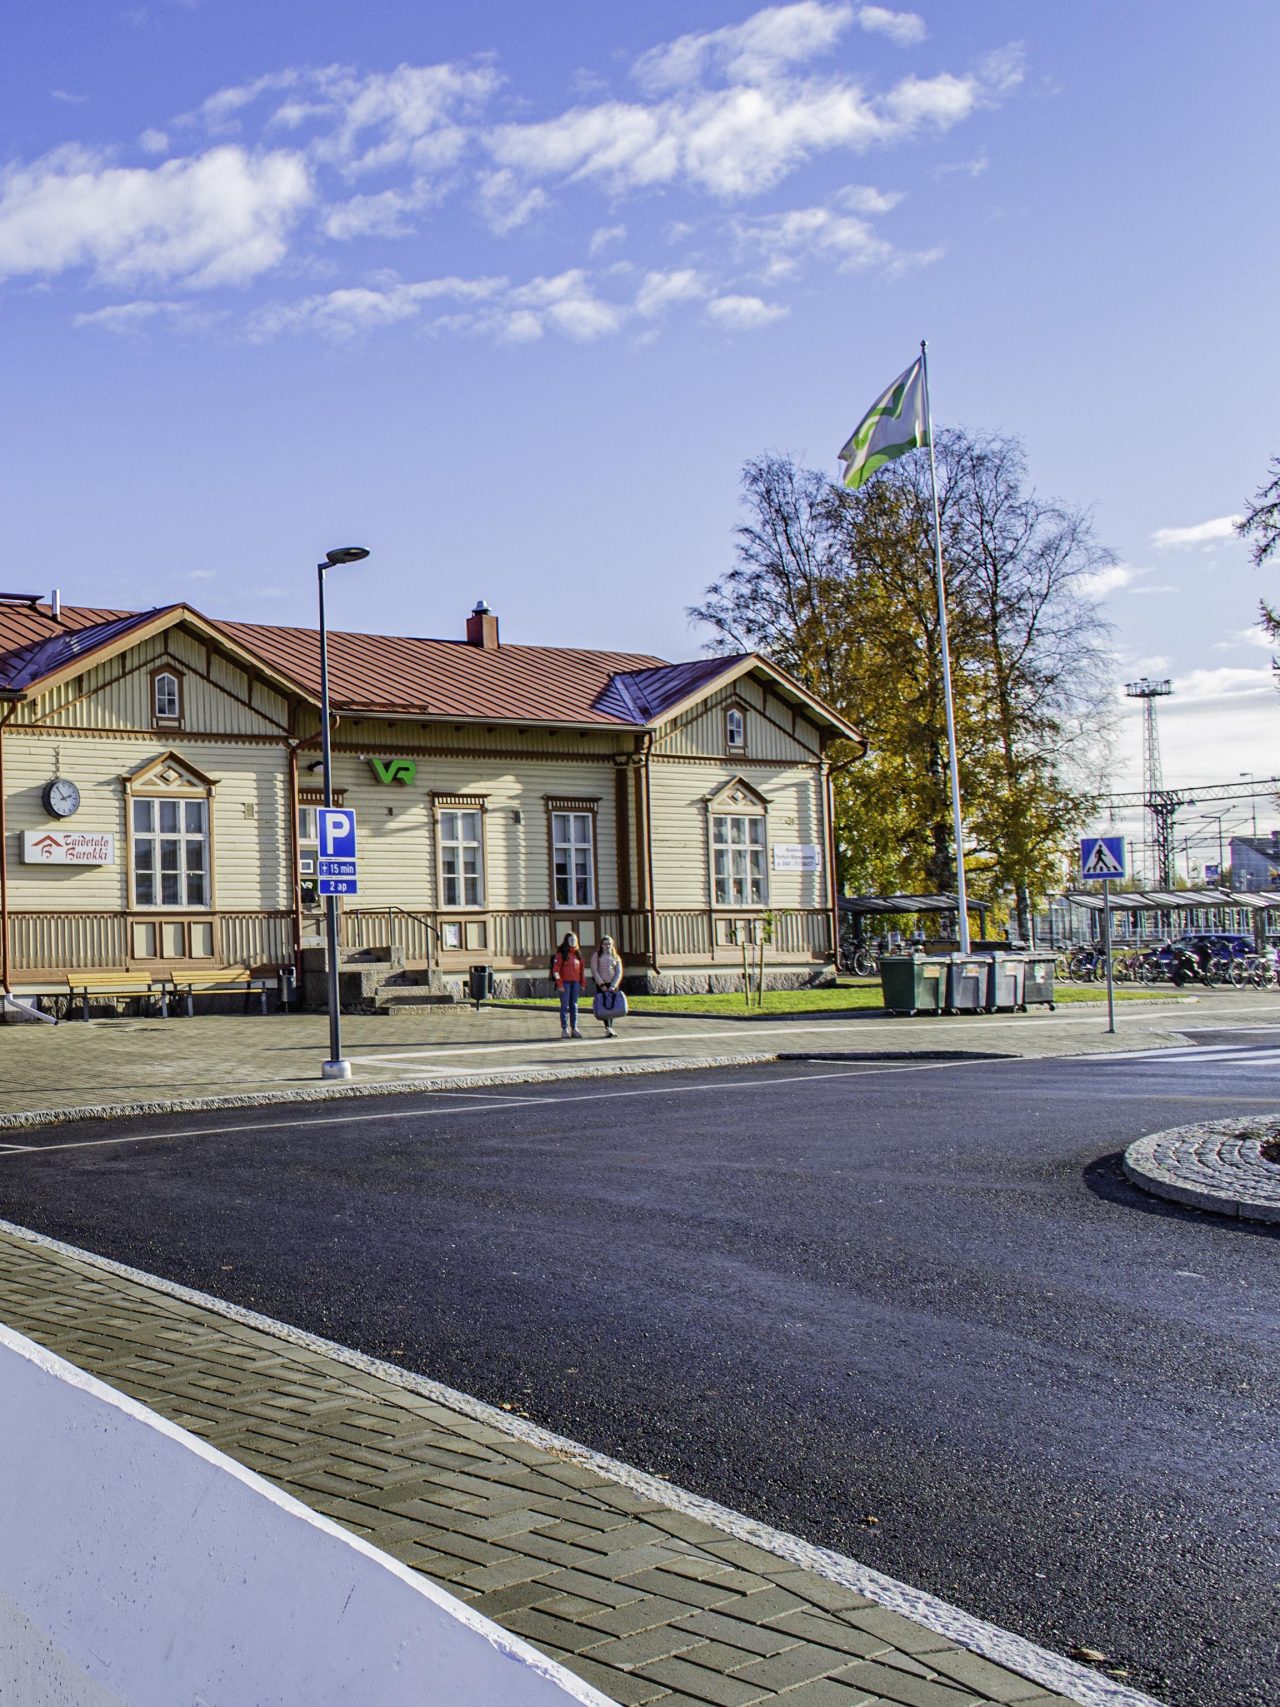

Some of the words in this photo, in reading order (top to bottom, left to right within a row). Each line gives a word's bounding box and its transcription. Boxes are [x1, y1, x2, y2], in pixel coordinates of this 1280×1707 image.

[372, 758, 417, 785] VR
[325, 812, 351, 855] P
[63, 834, 109, 847] Taidetalo
[65, 847, 108, 861] Barokki
[330, 863, 339, 874] 15
[340, 863, 355, 874] min
[329, 881, 335, 891] 2
[337, 882, 347, 892] ap
